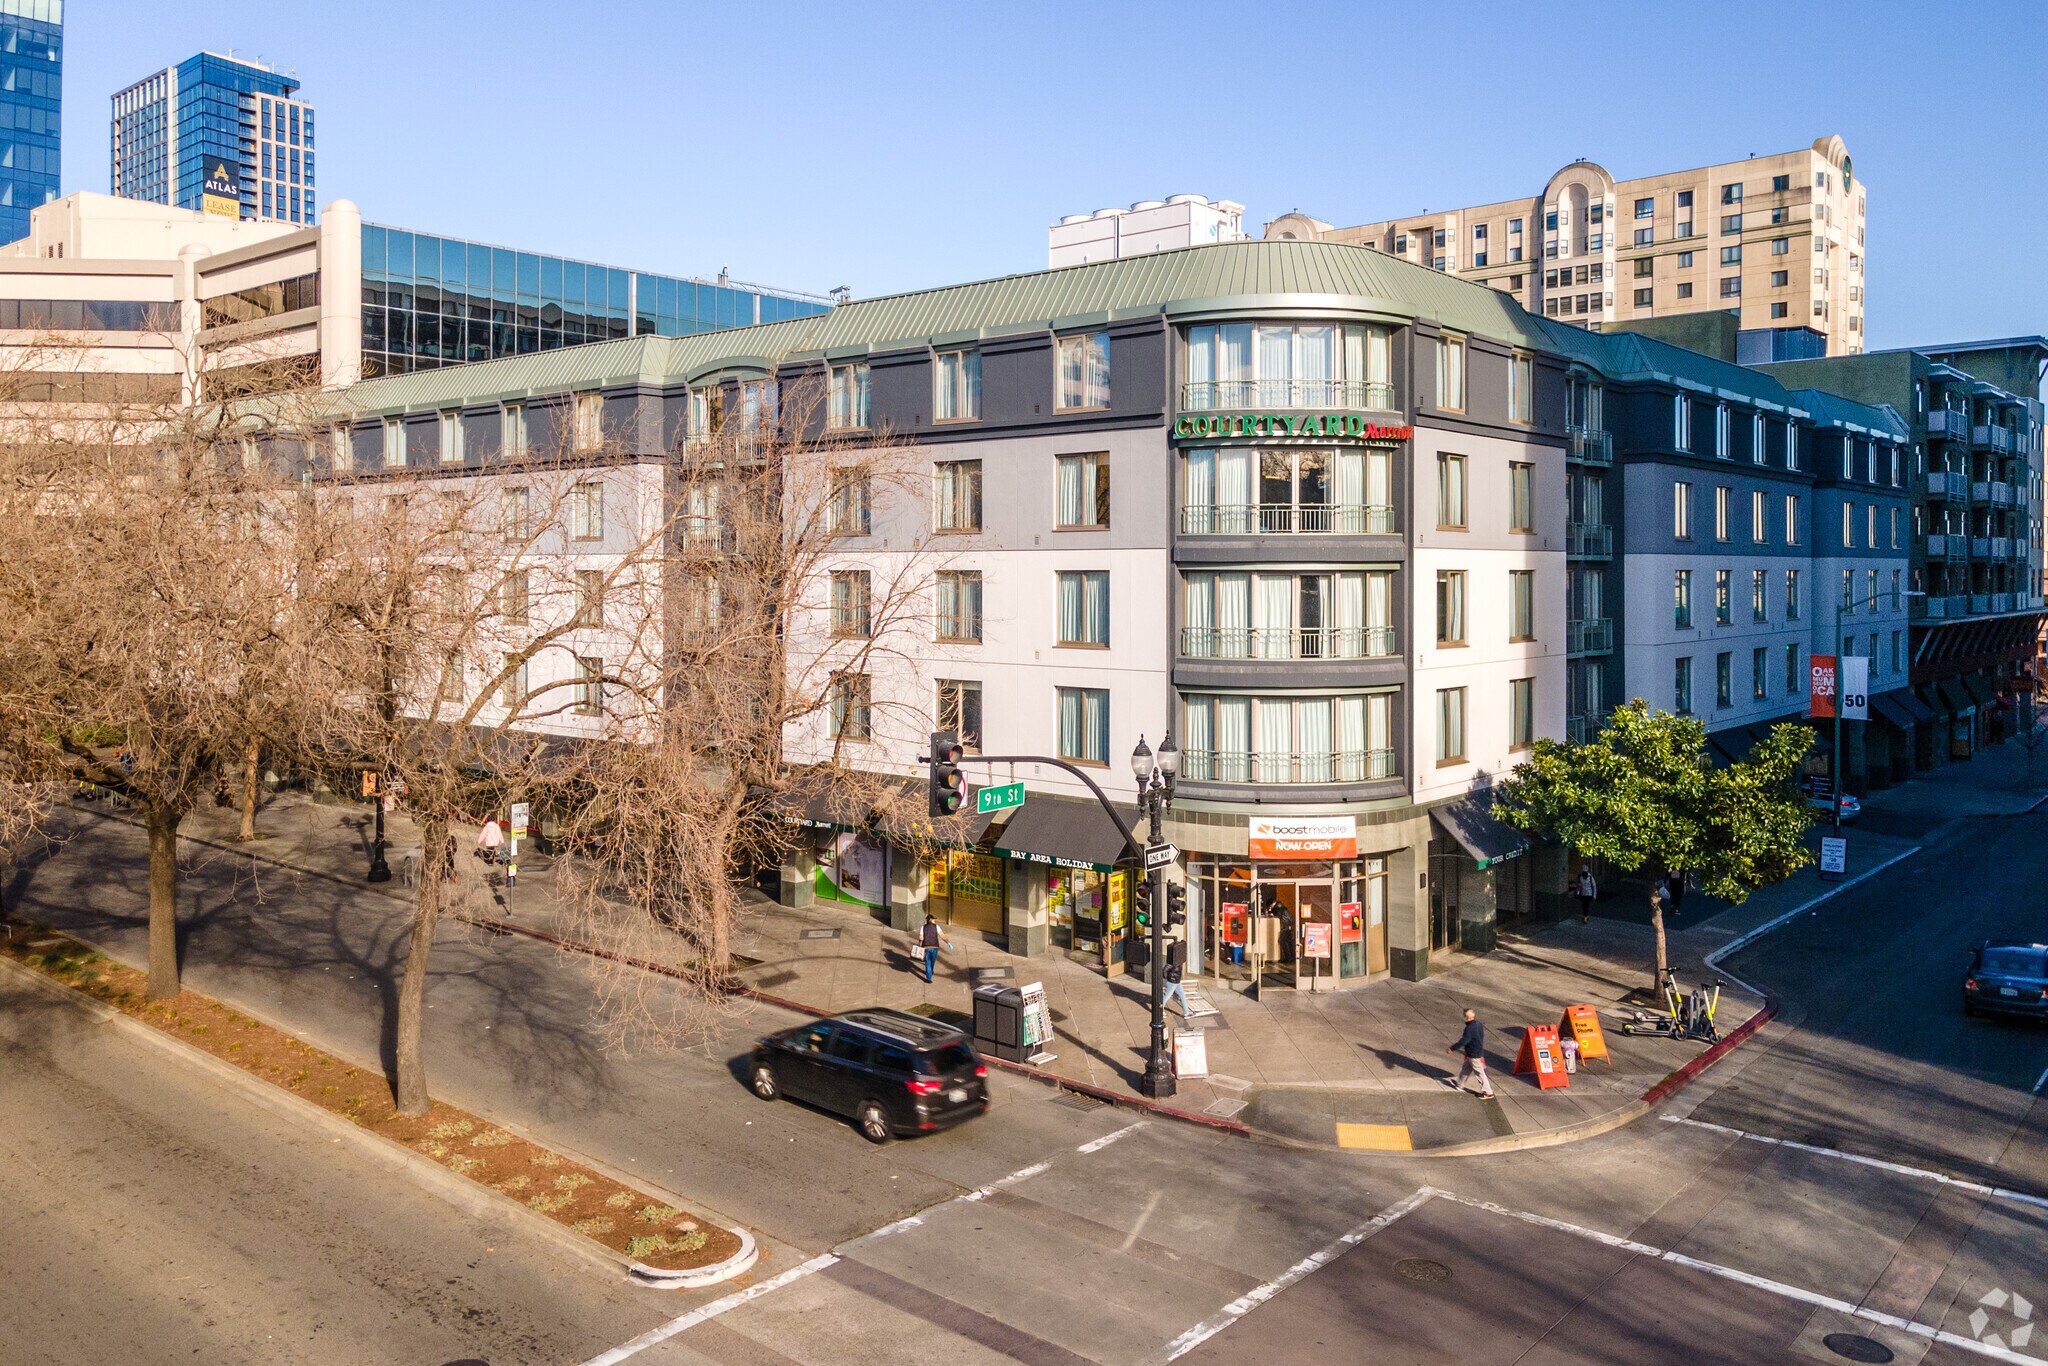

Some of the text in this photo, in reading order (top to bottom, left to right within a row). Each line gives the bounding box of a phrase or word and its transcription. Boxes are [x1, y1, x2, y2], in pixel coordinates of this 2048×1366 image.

[205, 180, 237, 194] ATLAS
[206, 199, 237, 213] LEASE
[1175, 415, 1414, 440] COURTYARD Marriott
[1844, 694, 1866, 708] 50
[984, 788, 1019, 806] 9th St
[1275, 841, 1332, 851] NOW OPEN
[1010, 850, 1094, 871] BAY AREA HOLIDAY
[1149, 851, 1171, 863] ONE WAY
